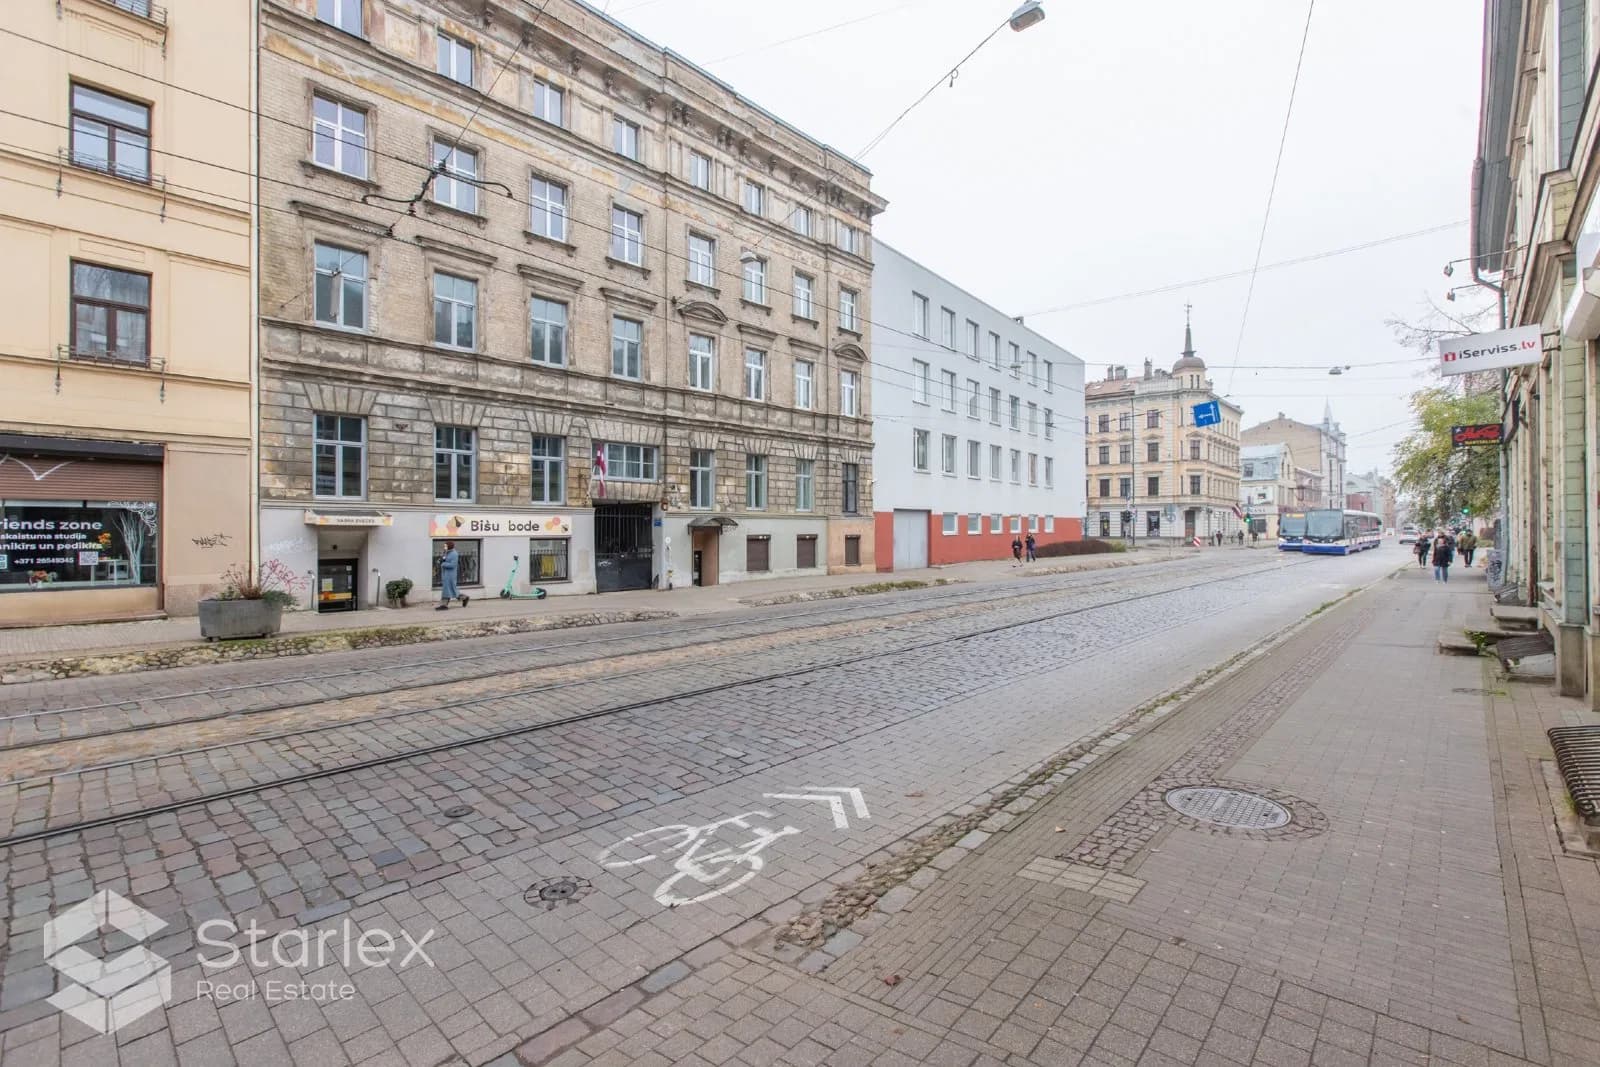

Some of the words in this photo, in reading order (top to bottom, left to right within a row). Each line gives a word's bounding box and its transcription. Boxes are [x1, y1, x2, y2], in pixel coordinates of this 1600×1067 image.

[1459, 340, 1536, 359] iServiss.lv
[59, 521, 104, 530] zone
[508, 520, 540, 532] bode
[54, 533, 87, 541] studija
[0, 542, 37, 550] nikīrs
